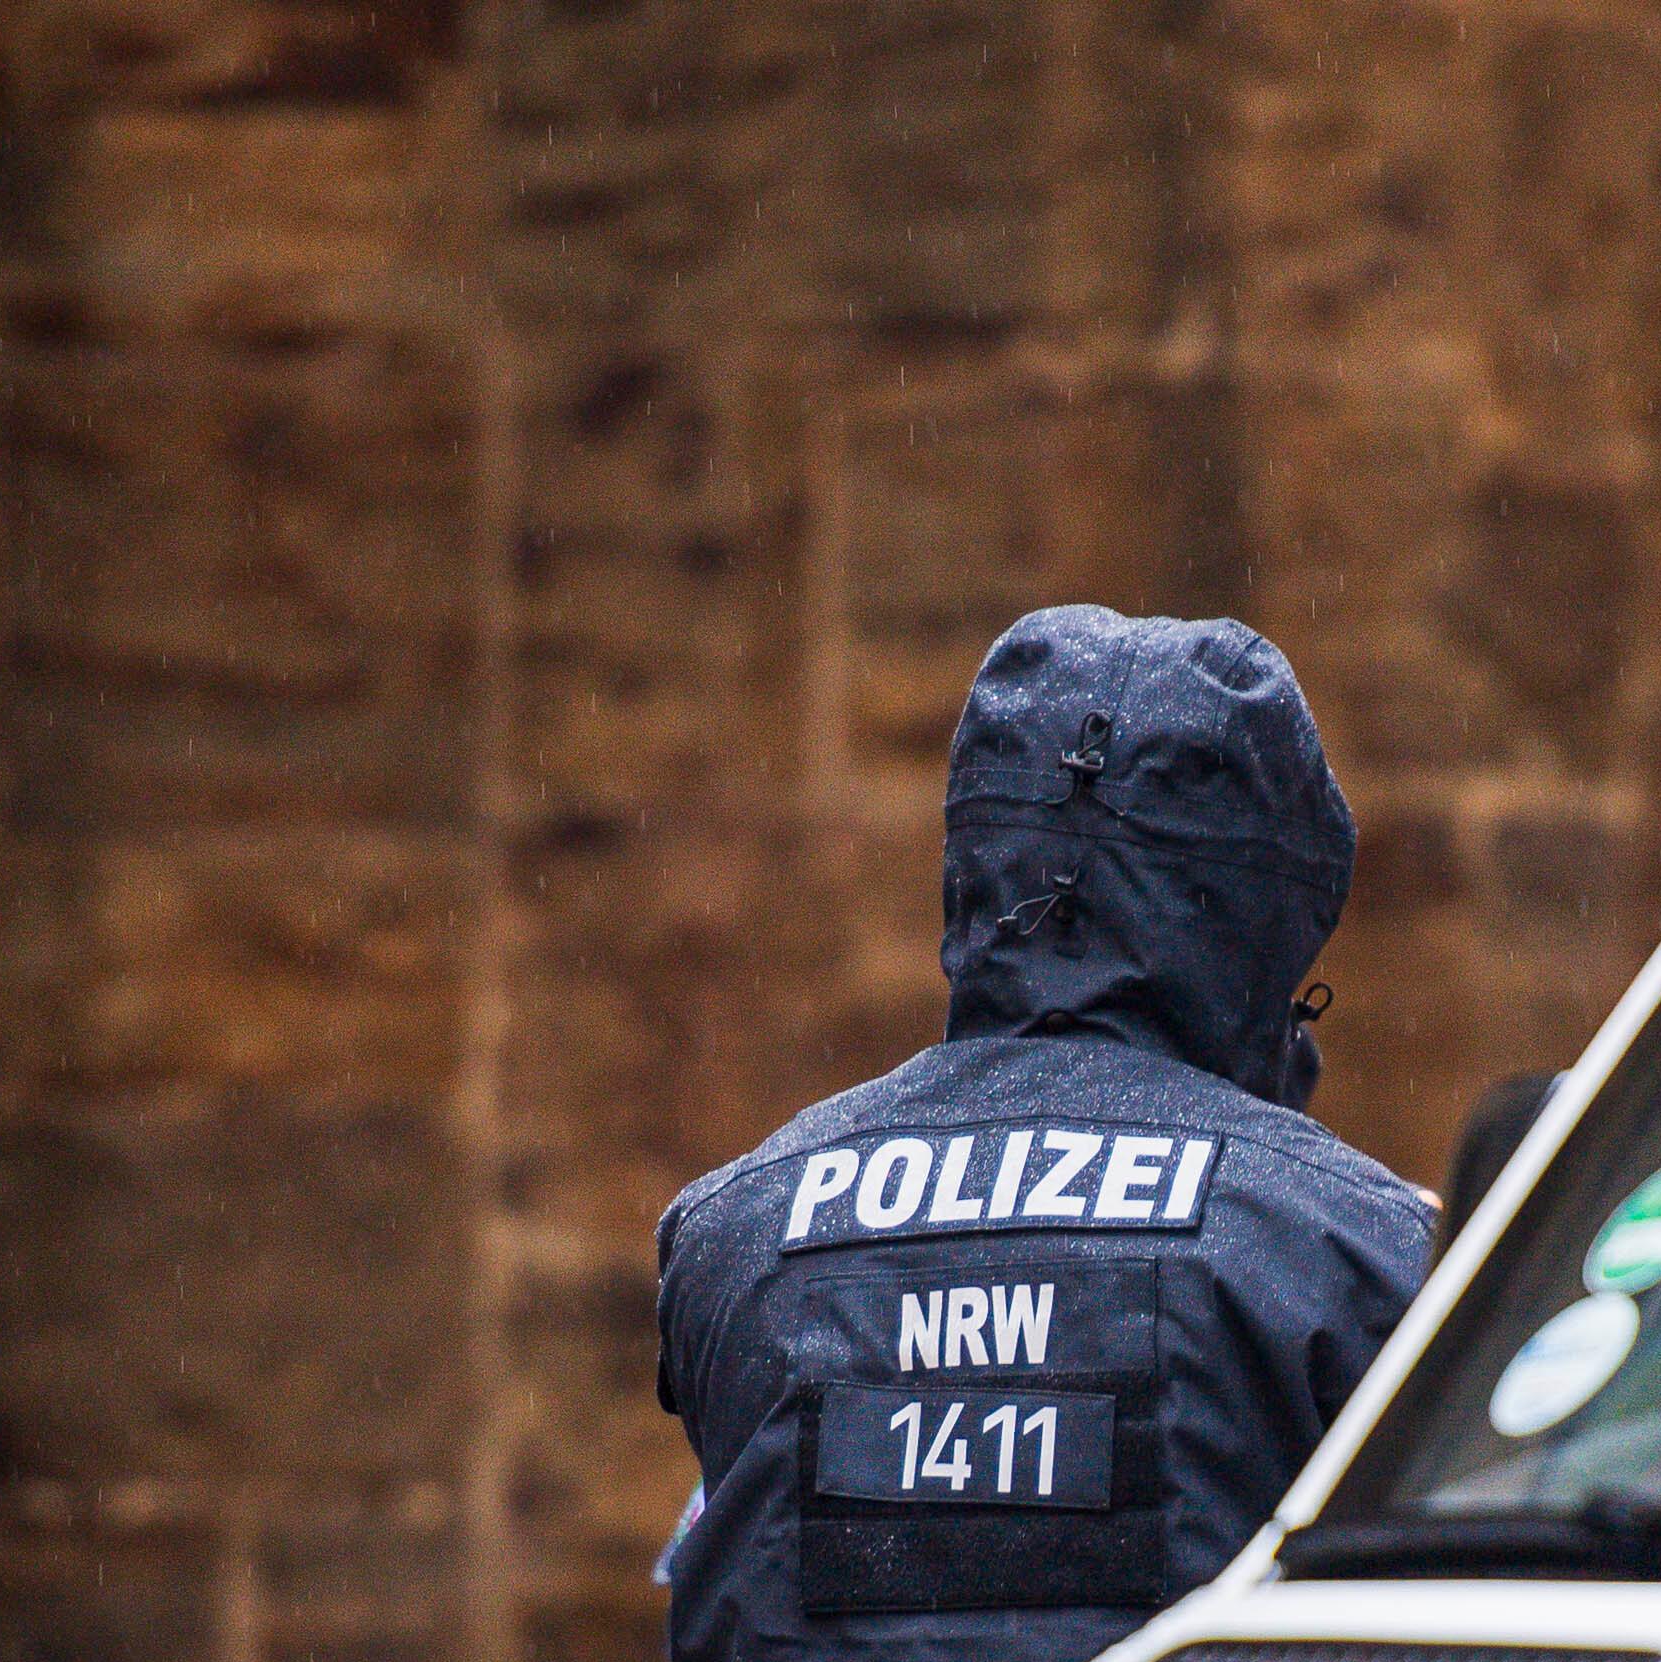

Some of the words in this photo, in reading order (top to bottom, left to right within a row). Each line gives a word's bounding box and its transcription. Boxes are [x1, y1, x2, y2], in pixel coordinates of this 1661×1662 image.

[785, 1130, 1213, 1241] POLIZEI
[898, 1283, 1055, 1372] NRW
[889, 1402, 1058, 1496] 1411
